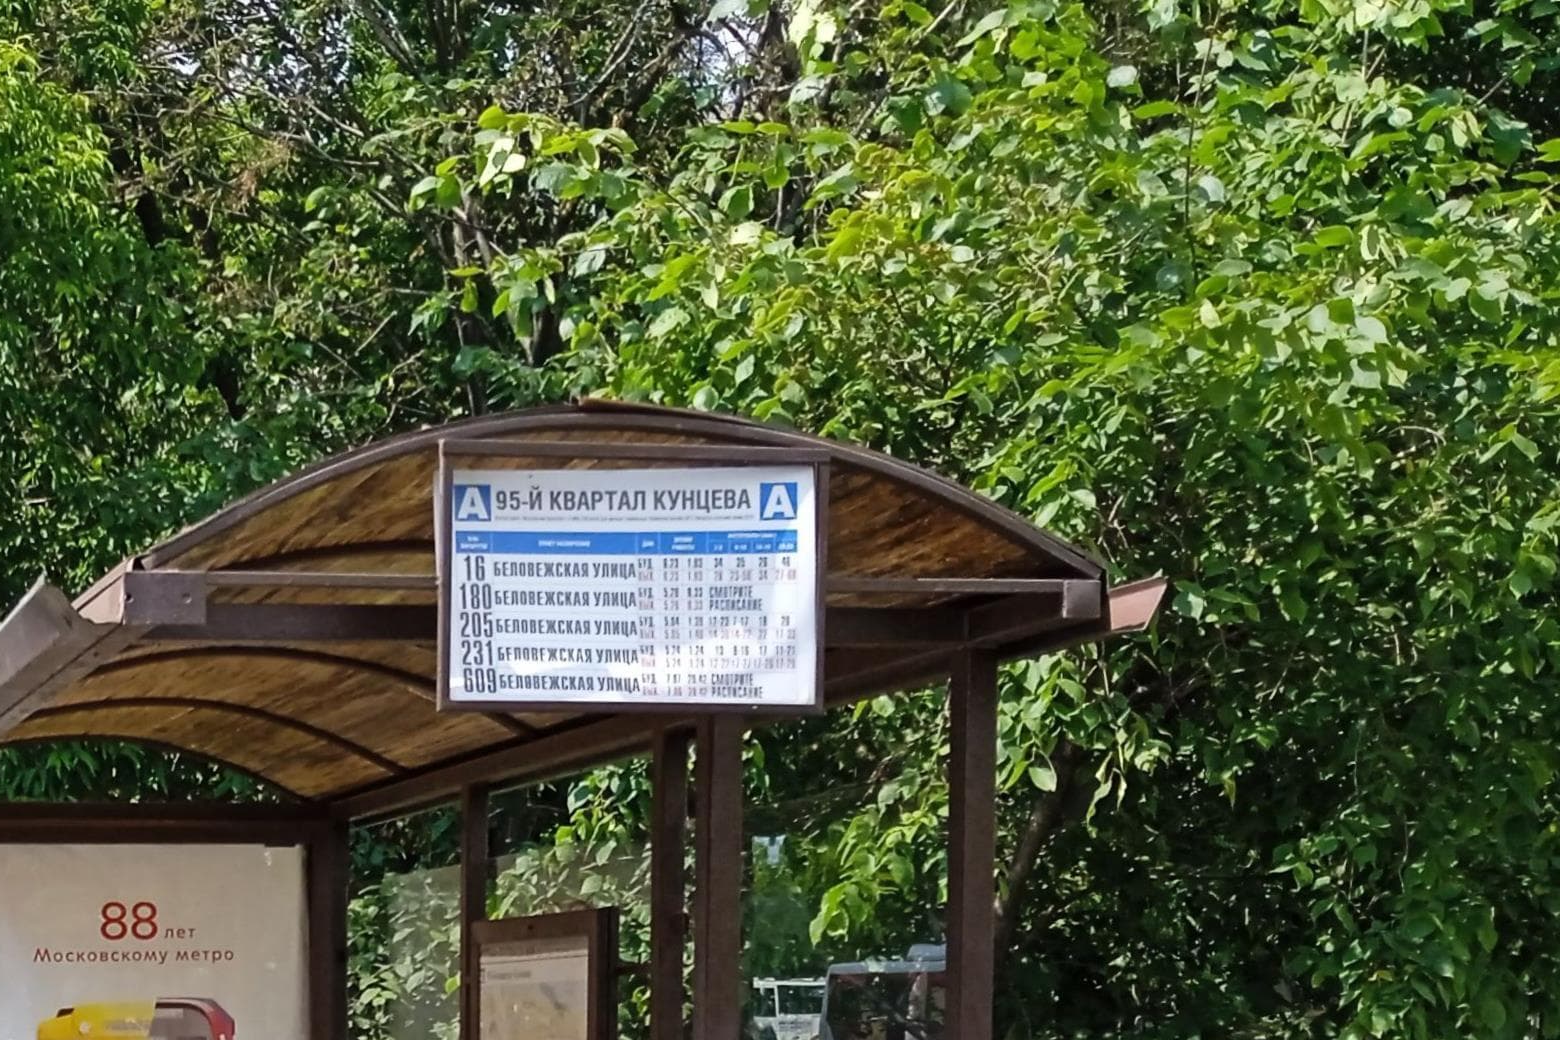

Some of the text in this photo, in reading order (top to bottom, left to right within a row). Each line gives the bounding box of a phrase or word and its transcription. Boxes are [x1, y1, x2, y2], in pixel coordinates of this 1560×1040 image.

[495, 486, 542, 511] 95-Й
[550, 489, 646, 511] КВАРТАЛ
[653, 488, 752, 513] КУНЦЕВА
[463, 555, 637, 581] 16 БЕЛОВЕЖСКАЯ УЛИЦА
[459, 583, 638, 610] 180 БЕЛОВЕЖСКАЯ УЛИЦА
[460, 611, 493, 638] 205
[496, 618, 591, 635] БЕЛОВЕЖСКАЯ
[594, 620, 638, 637] УЛИЦА
[461, 640, 493, 666] 231
[497, 646, 593, 663] БЕЛОВЕЖСКАЯ
[596, 648, 639, 665] УЛИЦА
[463, 668, 497, 693] 609
[499, 674, 595, 691] БЕЛОВЕЖСКАЯ
[597, 676, 641, 693] УЛИЦА
[100, 901, 197, 941] 88 лет
[33, 947, 235, 964] Московскому метро
